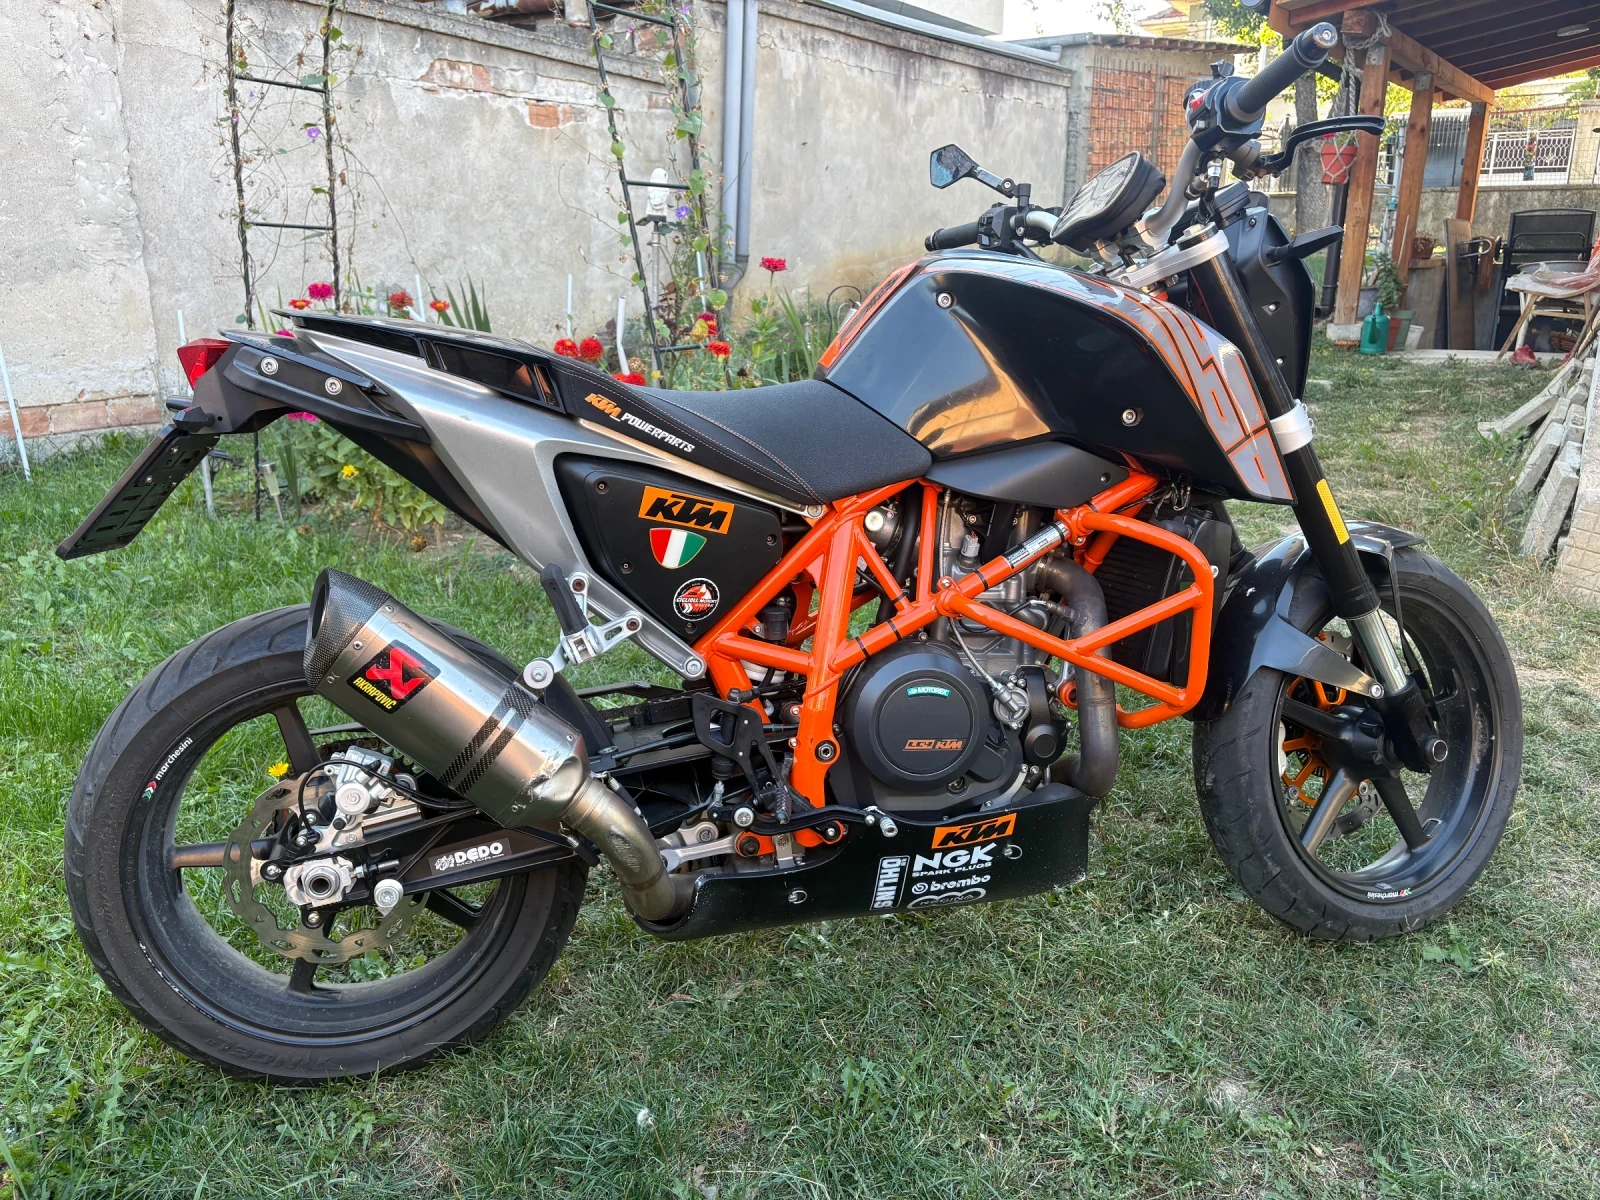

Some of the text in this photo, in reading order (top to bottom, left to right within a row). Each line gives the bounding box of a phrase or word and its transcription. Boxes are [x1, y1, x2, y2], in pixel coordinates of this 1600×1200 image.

[584, 392, 696, 452] KTM POWERPARTS
[645, 494, 728, 531] KTM
[353, 677, 397, 710] AKRAPOVIC
[917, 685, 947, 695] MOTOREX
[935, 739, 963, 749] KTM
[154, 737, 194, 781] marchesini
[937, 819, 1007, 846] KTM
[454, 842, 503, 864] DEDO
[912, 842, 998, 872] NGK
[873, 857, 906, 909] ÖHLINS
[911, 862, 993, 878] SPARK PLUGS
[930, 874, 991, 891] brembo
[1367, 890, 1399, 900] marchesini
